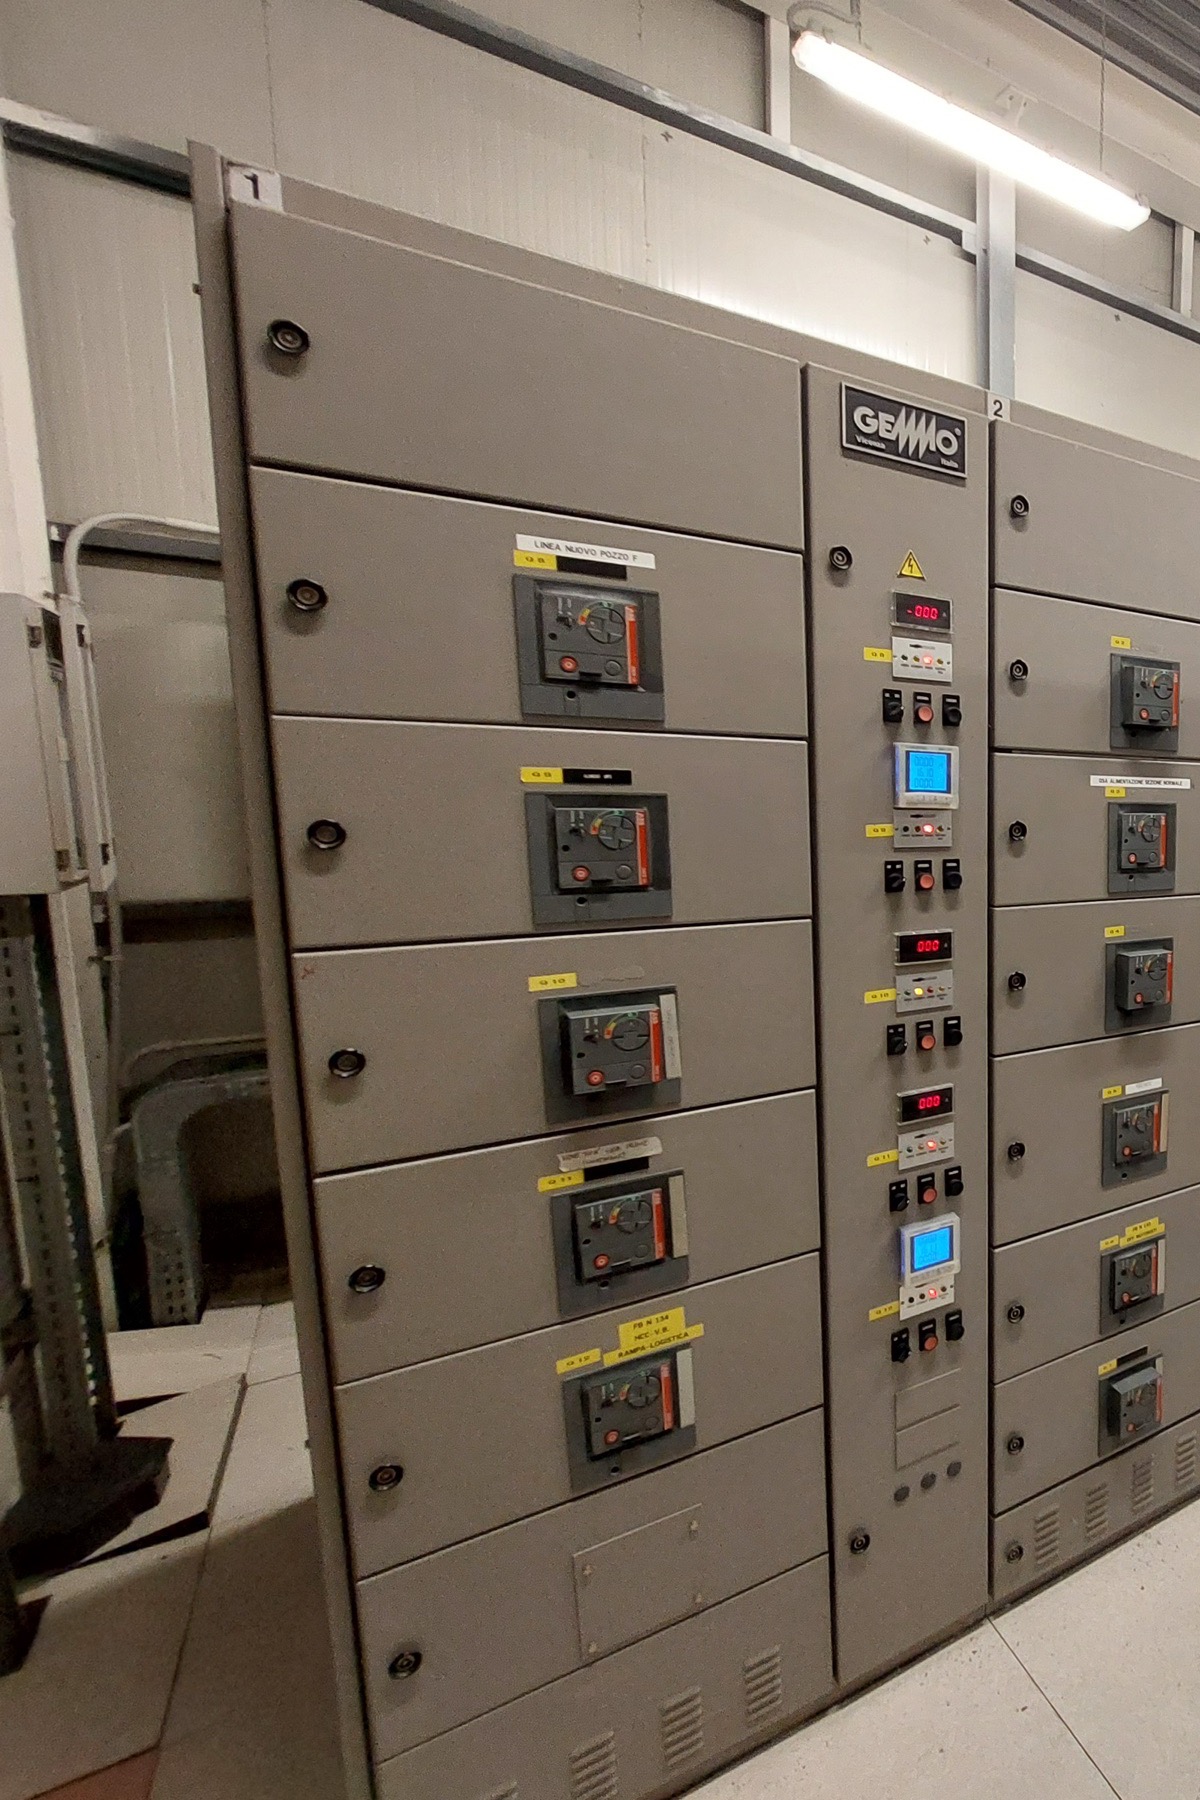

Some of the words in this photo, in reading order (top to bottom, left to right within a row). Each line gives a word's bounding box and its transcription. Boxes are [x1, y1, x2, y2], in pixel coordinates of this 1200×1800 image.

[243, 172, 260, 201] 1
[992, 399, 1003, 418] 2
[534, 540, 562, 552] LINEA
[564, 544, 597, 557] NUOVO
[600, 550, 629, 562] POZZO
[632, 554, 638, 562] F
[655, 1314, 669, 1324] 134
